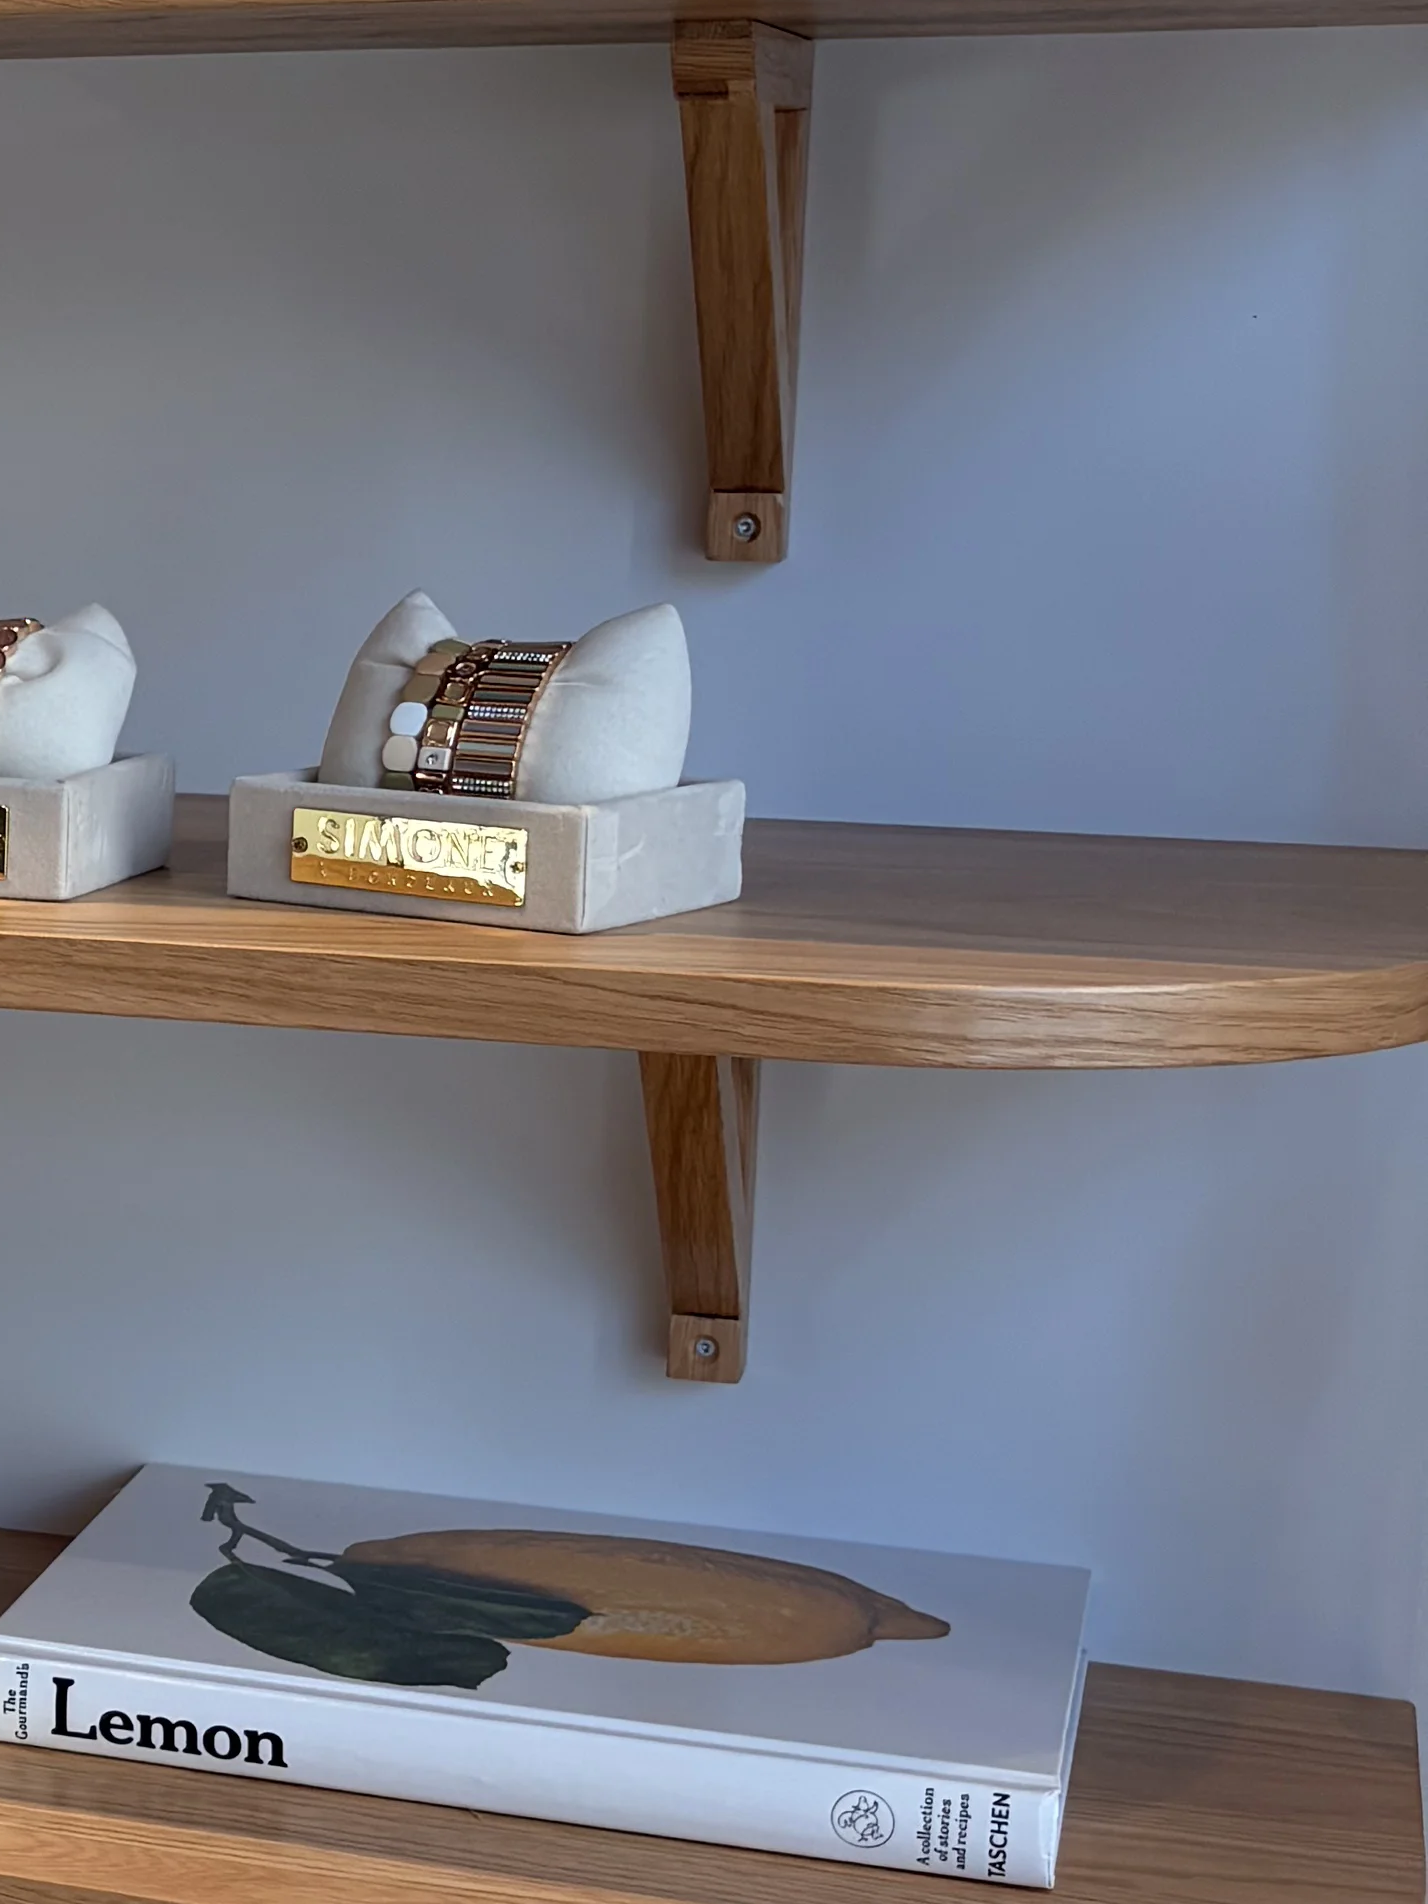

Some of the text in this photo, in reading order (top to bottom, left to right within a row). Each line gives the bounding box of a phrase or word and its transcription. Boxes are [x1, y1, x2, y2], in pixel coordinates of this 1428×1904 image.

[316, 816, 496, 872] SIMONE
[3, 1689, 17, 1714] The
[15, 1663, 30, 1740] Gourmand's
[51, 1677, 288, 1768] Lemon
[917, 1787, 934, 1855] collection
[934, 1798, 952, 1862] of stories
[952, 1793, 972, 1870] and recipes
[988, 1792, 1011, 1878] TASCHEN
